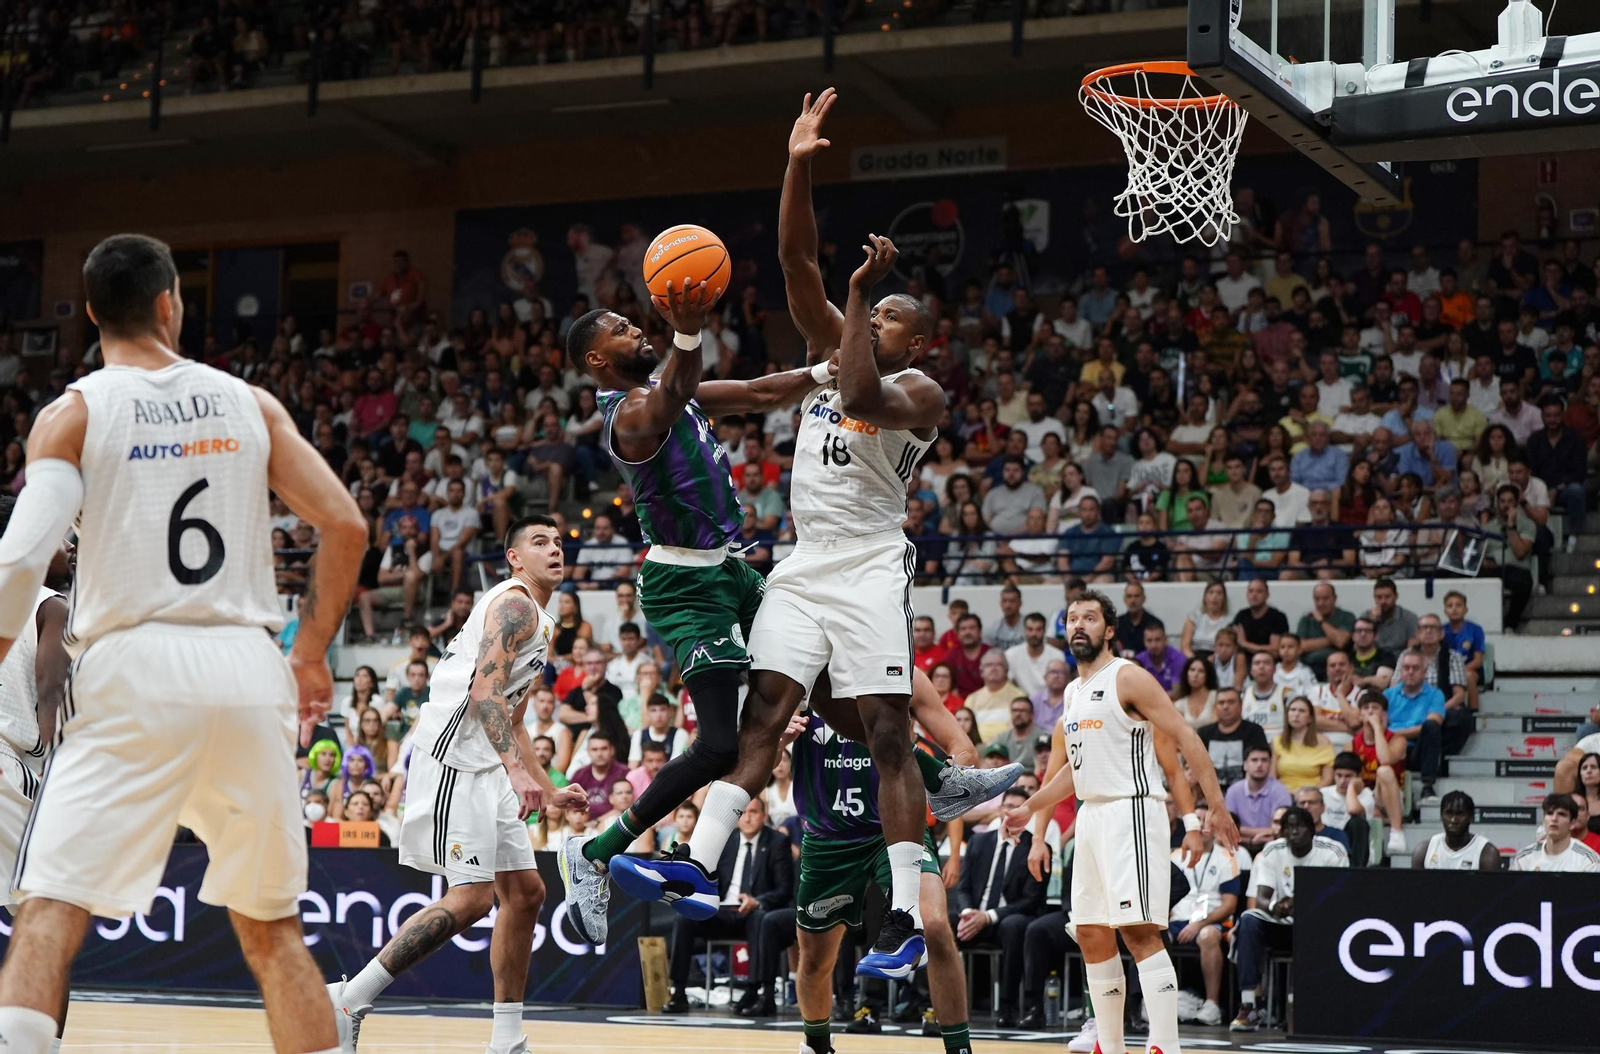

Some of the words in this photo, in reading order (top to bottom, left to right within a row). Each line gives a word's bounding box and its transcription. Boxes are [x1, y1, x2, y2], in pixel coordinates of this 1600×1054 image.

[858, 152, 928, 171] Grada
[938, 146, 999, 165] Norte
[663, 234, 698, 251] endesa
[133, 394, 225, 425] ABALDE
[128, 438, 239, 461] AUTOHERO
[822, 432, 851, 467] 18
[168, 477, 225, 585] 6
[824, 753, 872, 771] málaga
[832, 787, 865, 817] 45
